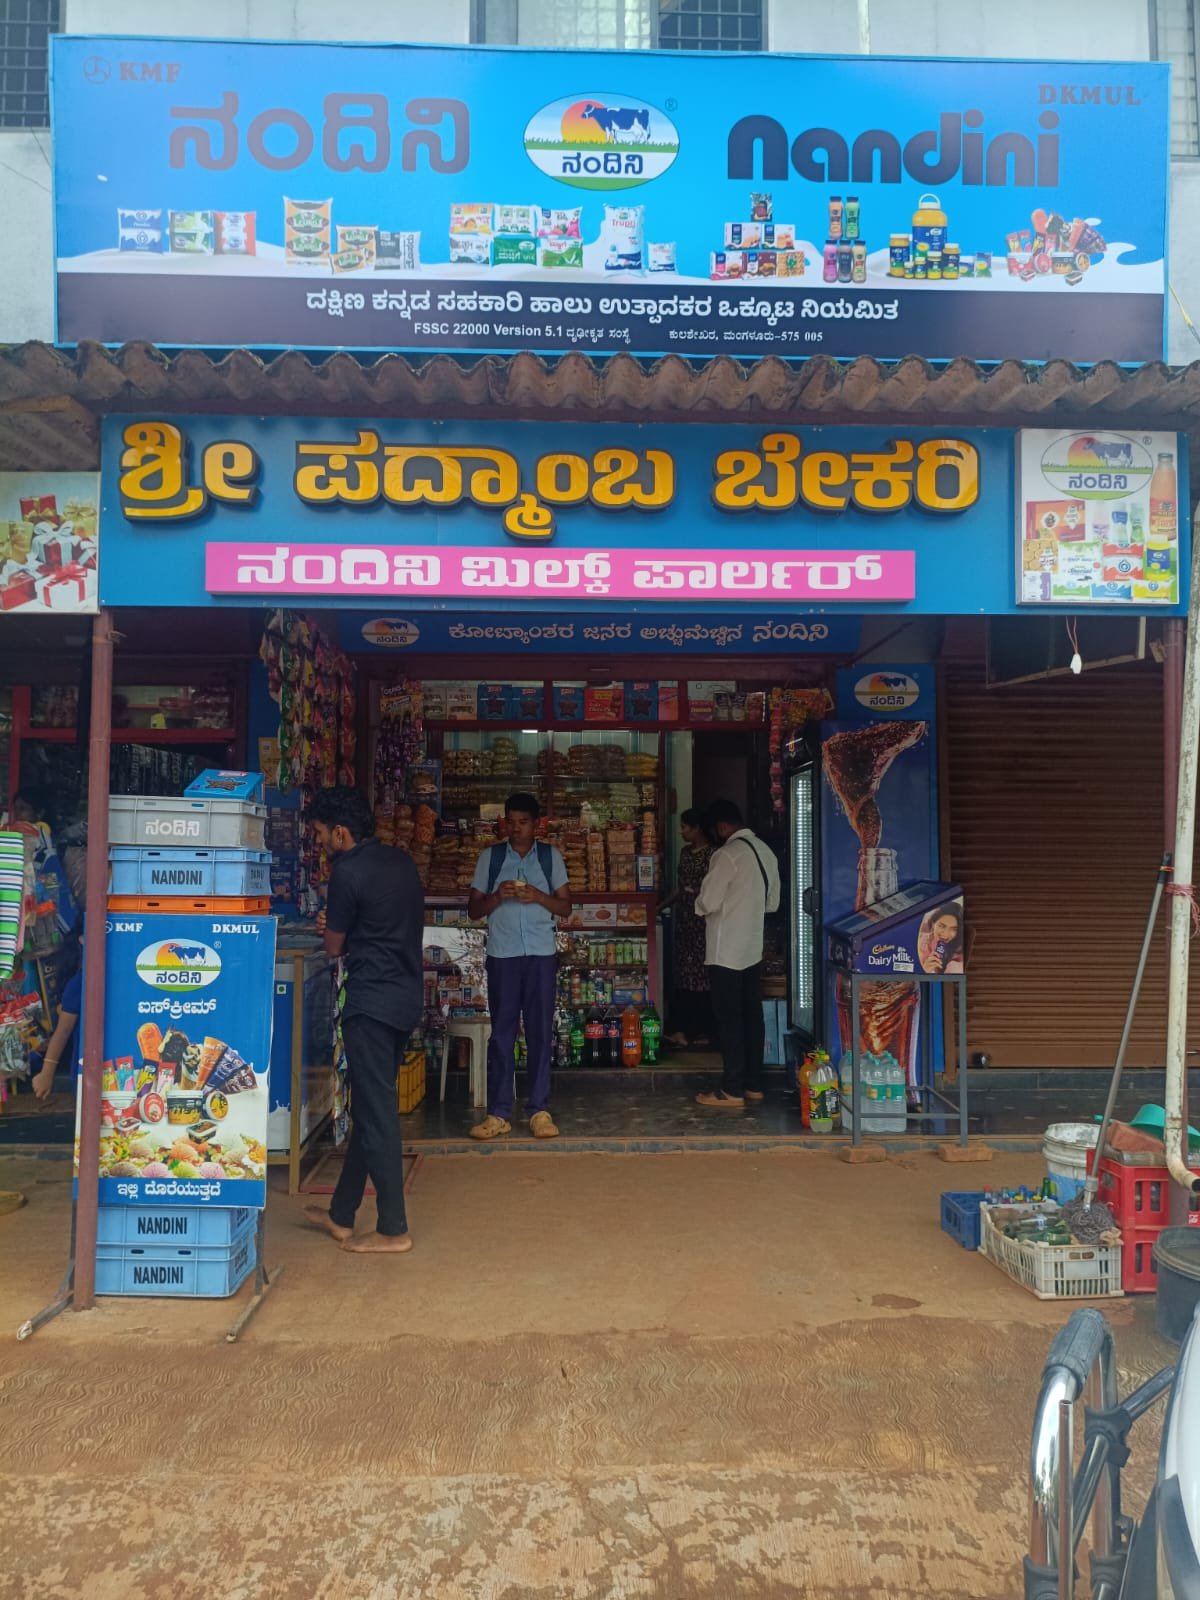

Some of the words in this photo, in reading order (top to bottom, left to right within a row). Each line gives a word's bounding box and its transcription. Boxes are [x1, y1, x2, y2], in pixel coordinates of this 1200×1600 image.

[119, 62, 181, 83] KMF
[1038, 84, 1142, 106] DKMUL
[168, 90, 470, 174] ನಂದಿನಿ
[562, 152, 643, 174] ನಂದಿನಿ
[306, 288, 365, 317] ದಕ್ಷಿಣ
[372, 289, 431, 320] ಕನ್ನಡ
[437, 290, 524, 313] ಸಹಕಾರಿ
[530, 295, 592, 314] ಹಾಲು
[599, 295, 712, 324] ಉತ್ಪಾದಕರ
[718, 297, 795, 326] ಒಕ್ಕೂಟ
[801, 298, 899, 320] ನಿಯಮಿತ
[414, 322, 449, 335] FSSC
[453, 323, 490, 335] 22000
[493, 323, 541, 337] Version
[545, 325, 563, 337] 5.1
[804, 331, 823, 342] 005
[119, 421, 259, 520] ಶ್ರೀ
[295, 430, 676, 540] ಪದ್ಮಾಂಬ
[713, 432, 981, 514] ಬೇಕರಿ
[1068, 473, 1128, 490] ನಂದಿನಿ
[237, 547, 441, 587] ನಂದಿನಿ
[461, 551, 611, 596] ಮಿಲ್ಕ್
[633, 554, 883, 591] ಪಾರ್ಲರ್
[449, 622, 575, 645] ಕೋಟ್ಯಾಂತರ
[582, 623, 633, 642] ಜನರ
[640, 623, 743, 646] ಅಚ್ಚುಮೆಚ್ಚಿನ
[752, 621, 829, 643] ನಂದಿನಿ
[869, 694, 906, 706] ನಂದಿನಿ
[145, 818, 200, 837] ನಂದಿನಿ
[151, 869, 203, 886] NANDINI
[115, 922, 144, 933] KMF
[211, 923, 260, 935] DKMUL
[869, 955, 891, 966] Dairy
[893, 951, 914, 962] Milk
[156, 970, 202, 984] ನಂದಿನಿ
[117, 1182, 139, 1199] ಇಲ್ಲಿ
[145, 1180, 222, 1201] ದೊರೆಯುತ್ತದೆ
[137, 1216, 188, 1235] NANDINI
[133, 1266, 184, 1285] NANDINI
